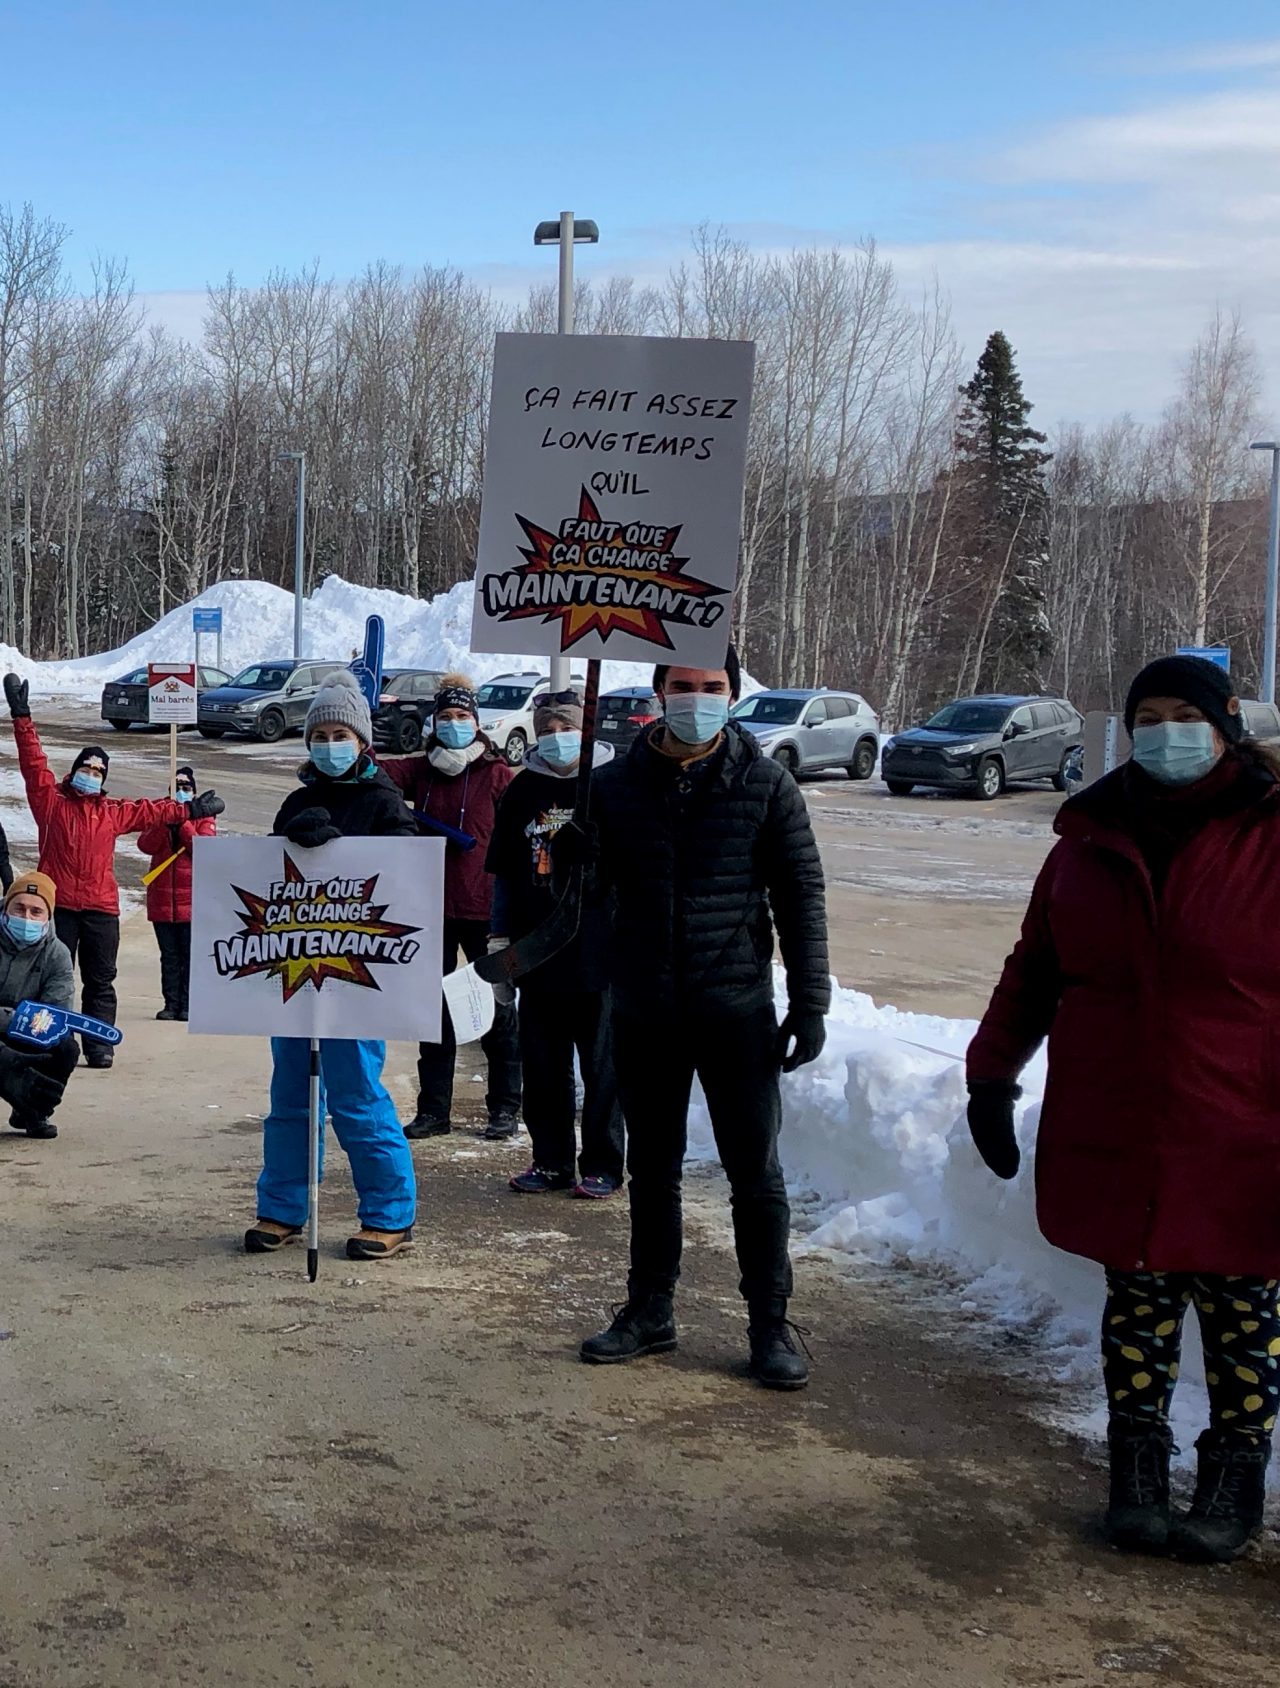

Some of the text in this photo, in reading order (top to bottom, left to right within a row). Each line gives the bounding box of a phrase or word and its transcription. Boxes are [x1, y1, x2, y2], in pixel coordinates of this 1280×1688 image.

[523, 387, 738, 419] ÇA FAIT ASSEZ
[541, 427, 714, 460] LONGTEMPS
[591, 470, 649, 496] QU'IL
[562, 520, 667, 547] FAUT QUE
[552, 544, 671, 571] ÇA CHANGE
[151, 696, 166, 704] Mal
[272, 879, 366, 900] FAUT QUE
[266, 902, 373, 926] ÇA CHANGE
